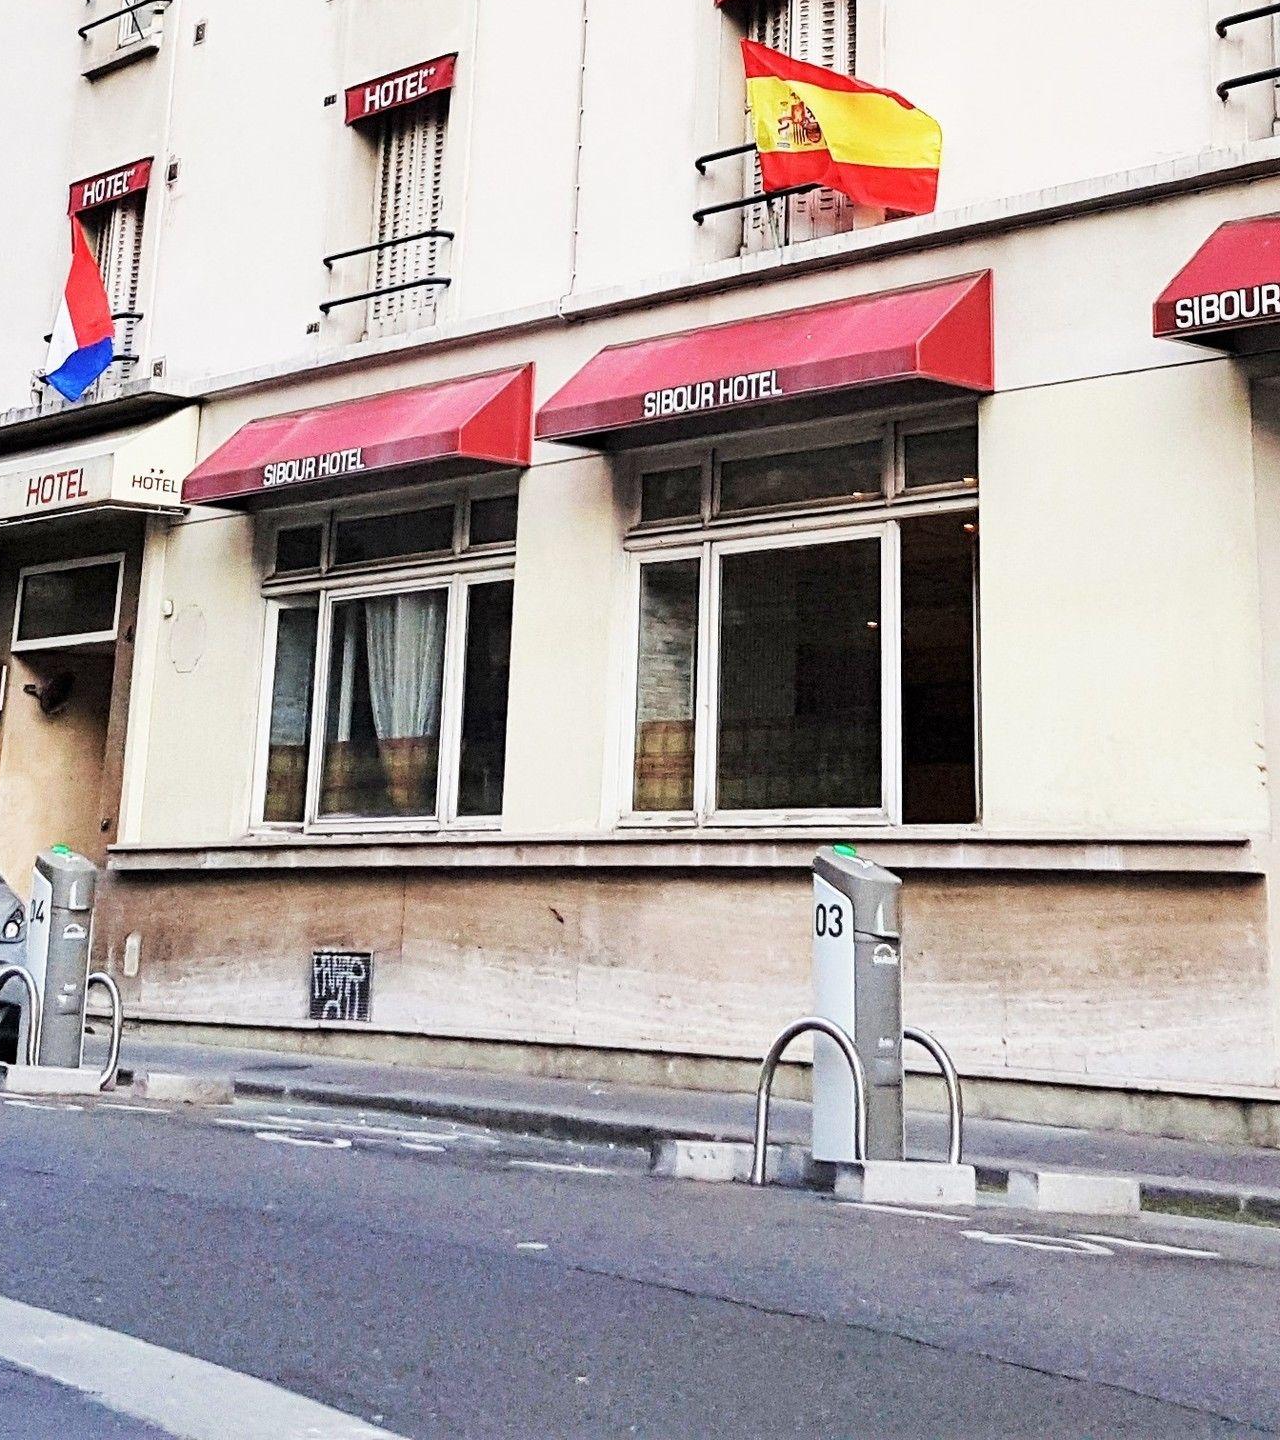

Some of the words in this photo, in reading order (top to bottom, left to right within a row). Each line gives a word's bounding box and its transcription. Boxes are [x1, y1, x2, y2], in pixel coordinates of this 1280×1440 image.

[364, 69, 428, 113] HOTEL
[82, 171, 130, 207] HOTEL
[1175, 283, 1280, 328] SIBOUR
[644, 381, 714, 418] SIBOUR
[720, 370, 782, 405] HOTEL
[132, 474, 179, 494] HOTEL
[263, 457, 316, 486] SIBOUR
[318, 447, 365, 476] HOTEL
[26, 468, 88, 507] HOTEL
[815, 903, 844, 938] 03
